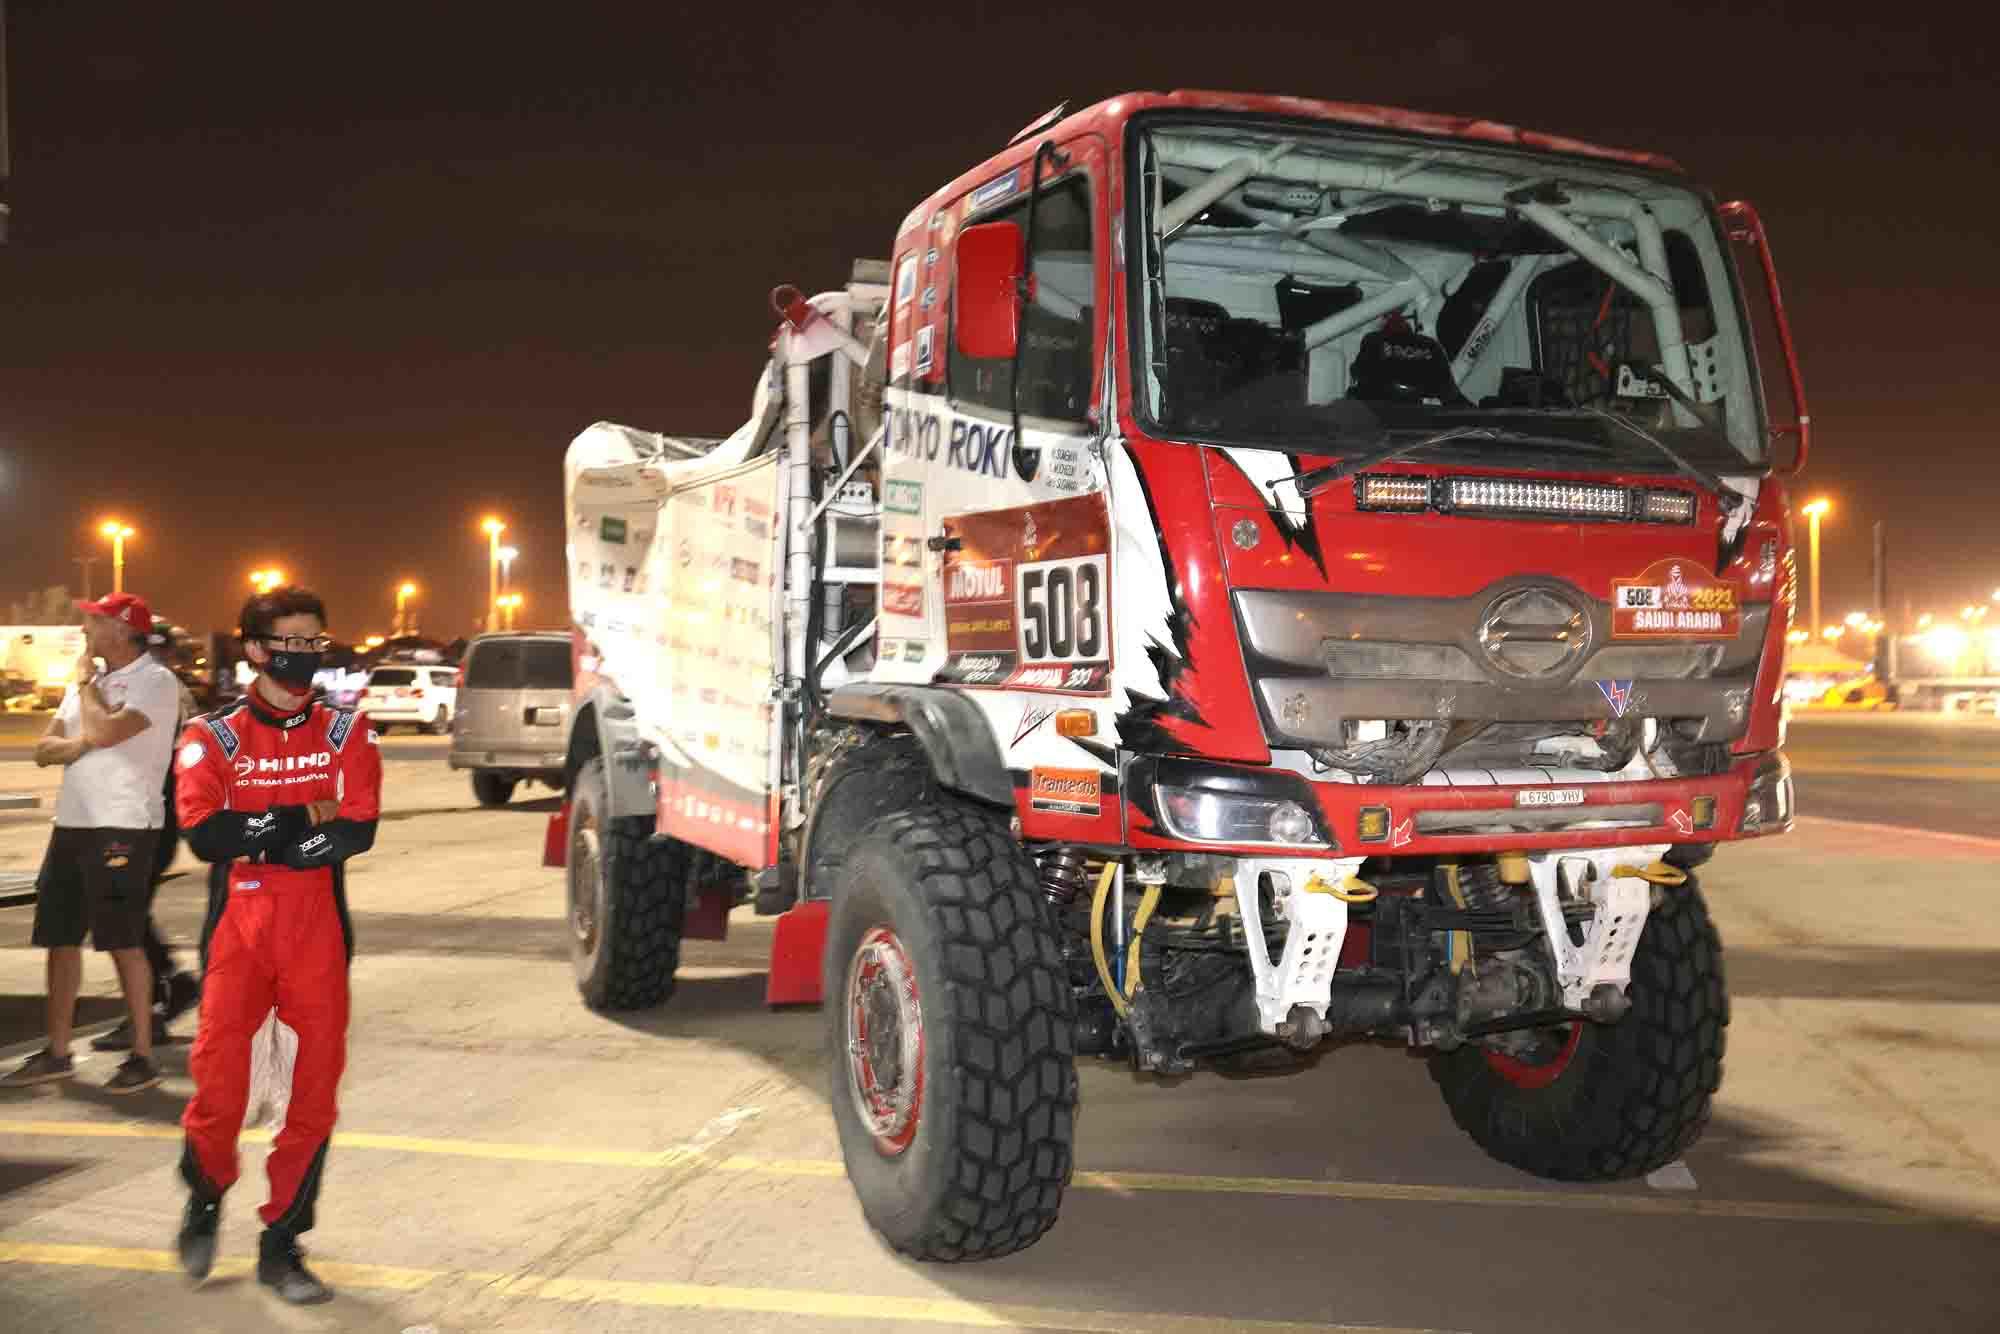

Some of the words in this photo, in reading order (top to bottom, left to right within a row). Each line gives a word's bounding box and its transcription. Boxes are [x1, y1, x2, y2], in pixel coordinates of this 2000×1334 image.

[945, 418, 1015, 479] ROKI
[950, 566, 1006, 600] MOTUL
[1022, 562, 1101, 659] 508
[1634, 611, 1675, 630] SAUDI
[1678, 611, 1723, 630] ARABIA
[258, 752, 331, 772] HINO
[252, 778, 283, 786] TEAM
[1528, 791, 1556, 803] 6790
